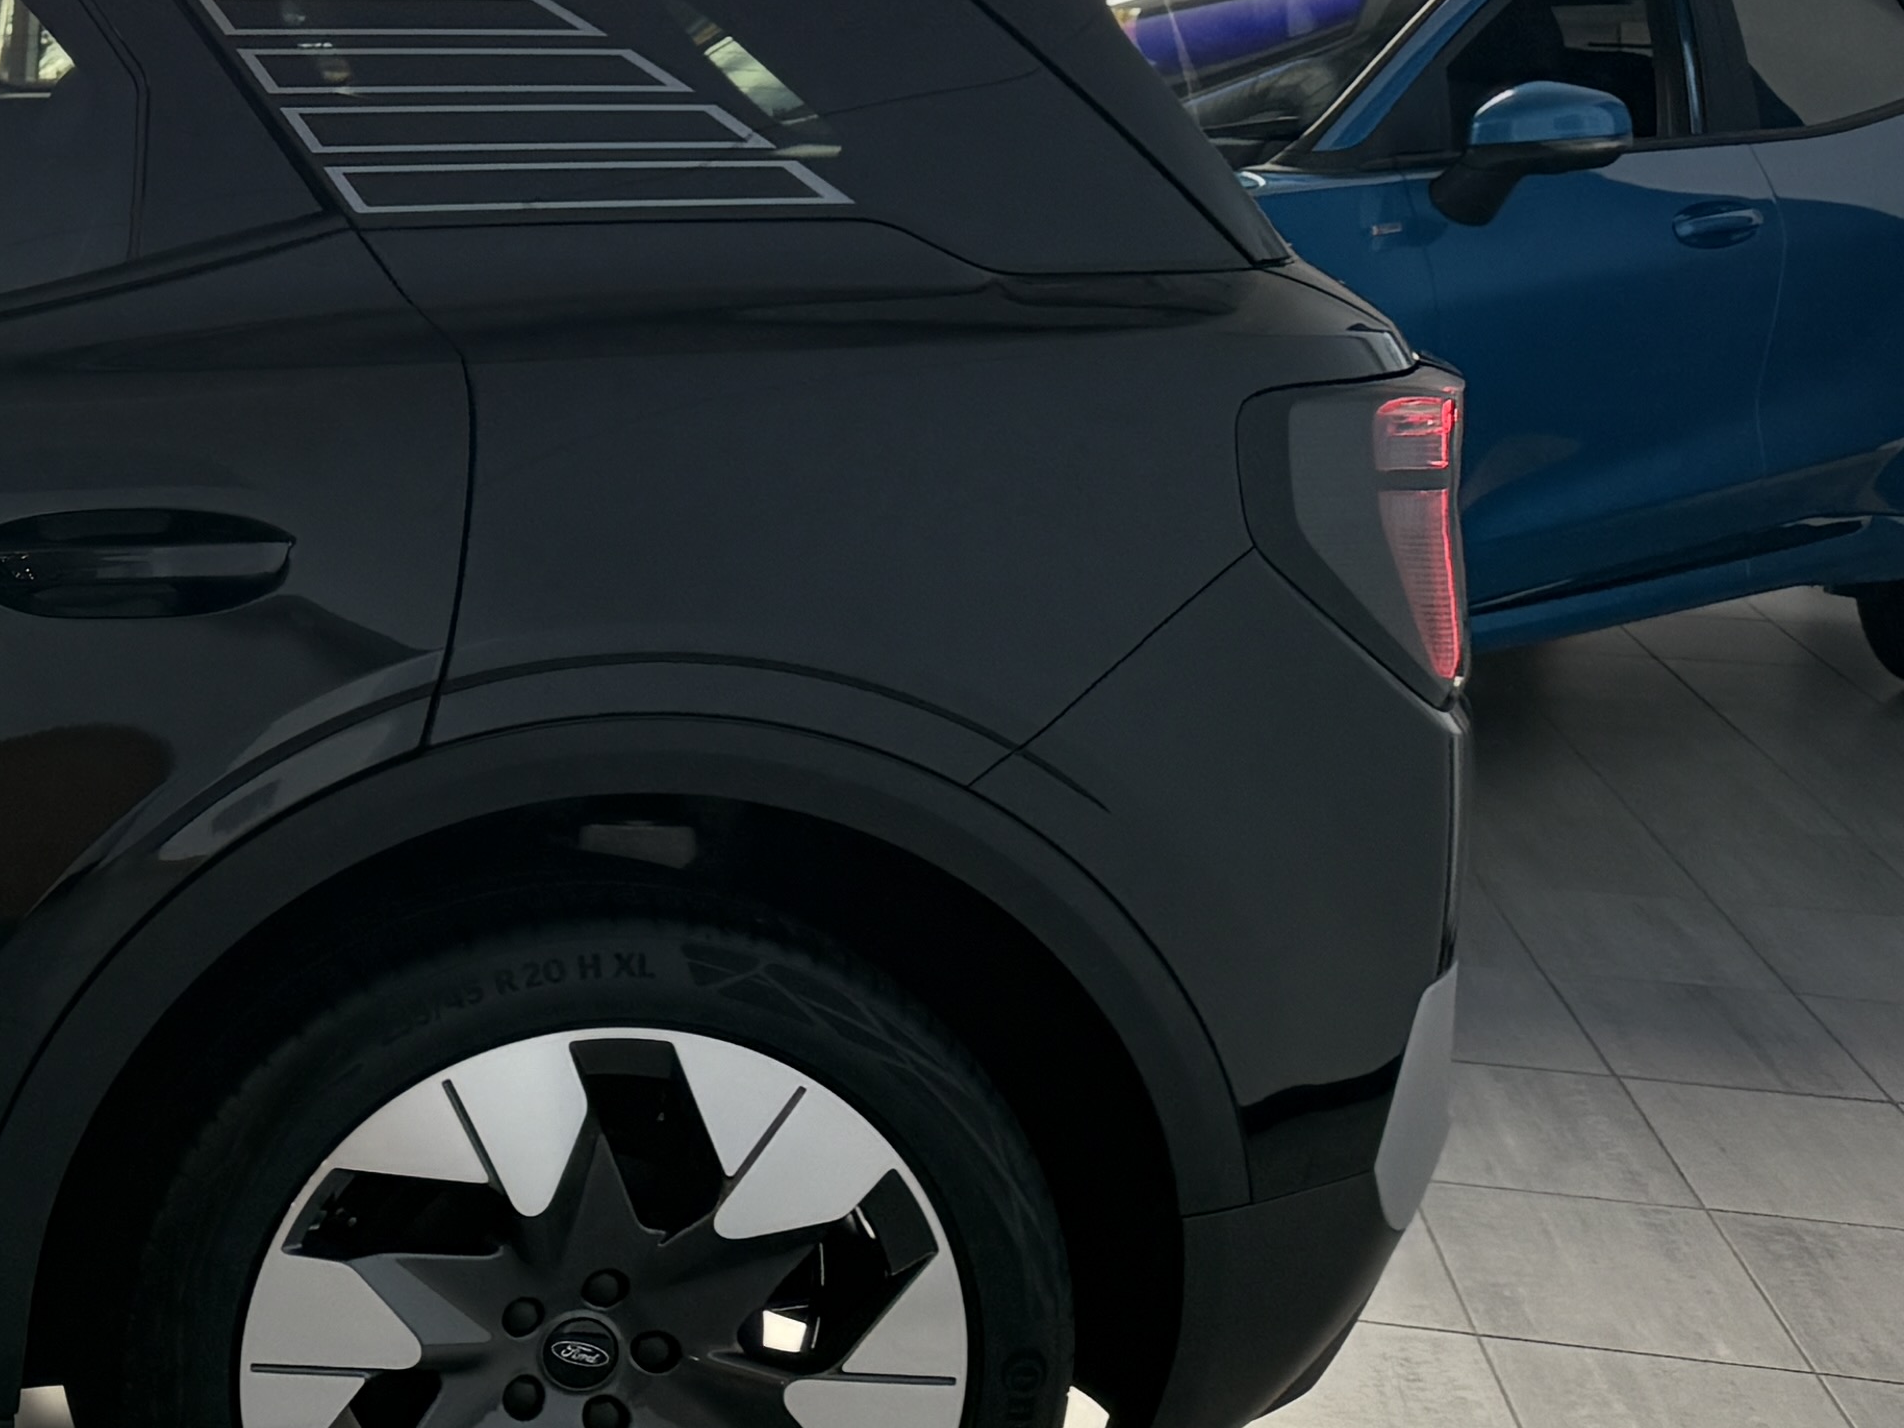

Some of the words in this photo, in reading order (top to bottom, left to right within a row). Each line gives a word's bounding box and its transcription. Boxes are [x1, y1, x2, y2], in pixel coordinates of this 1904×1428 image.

[577, 952, 603, 980] H
[612, 951, 657, 980] XL
[559, 1343, 602, 1365] Ford
